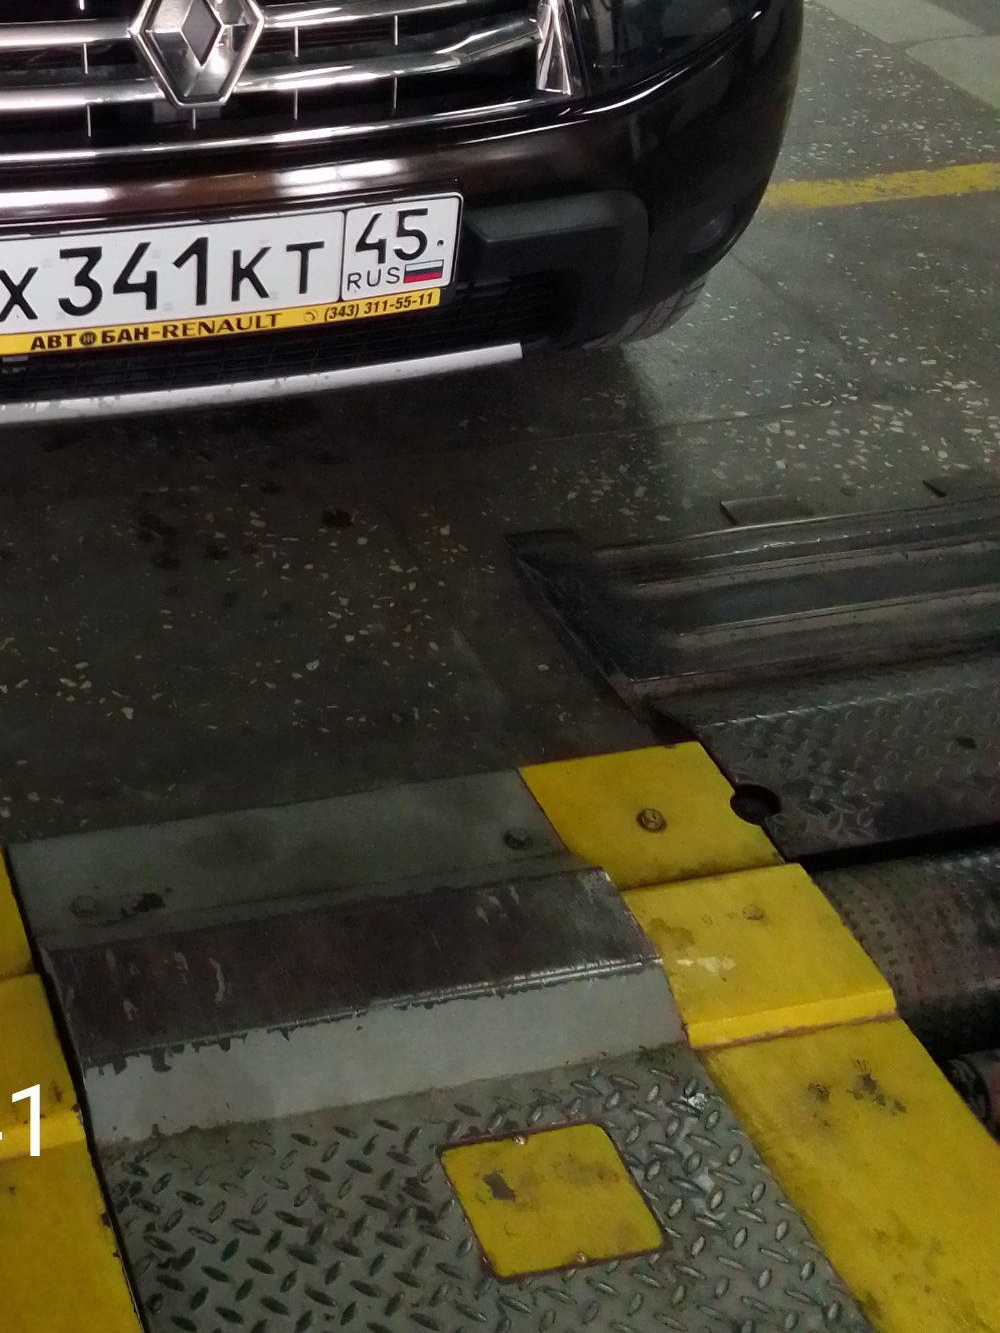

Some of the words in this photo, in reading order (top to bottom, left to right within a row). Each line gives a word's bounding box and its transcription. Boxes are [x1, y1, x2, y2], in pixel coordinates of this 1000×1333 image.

[355, 207, 429, 264] 45
[346, 266, 401, 292] RUS
[323, 303, 360, 323] (343)
[363, 291, 434, 315] 311-55-11
